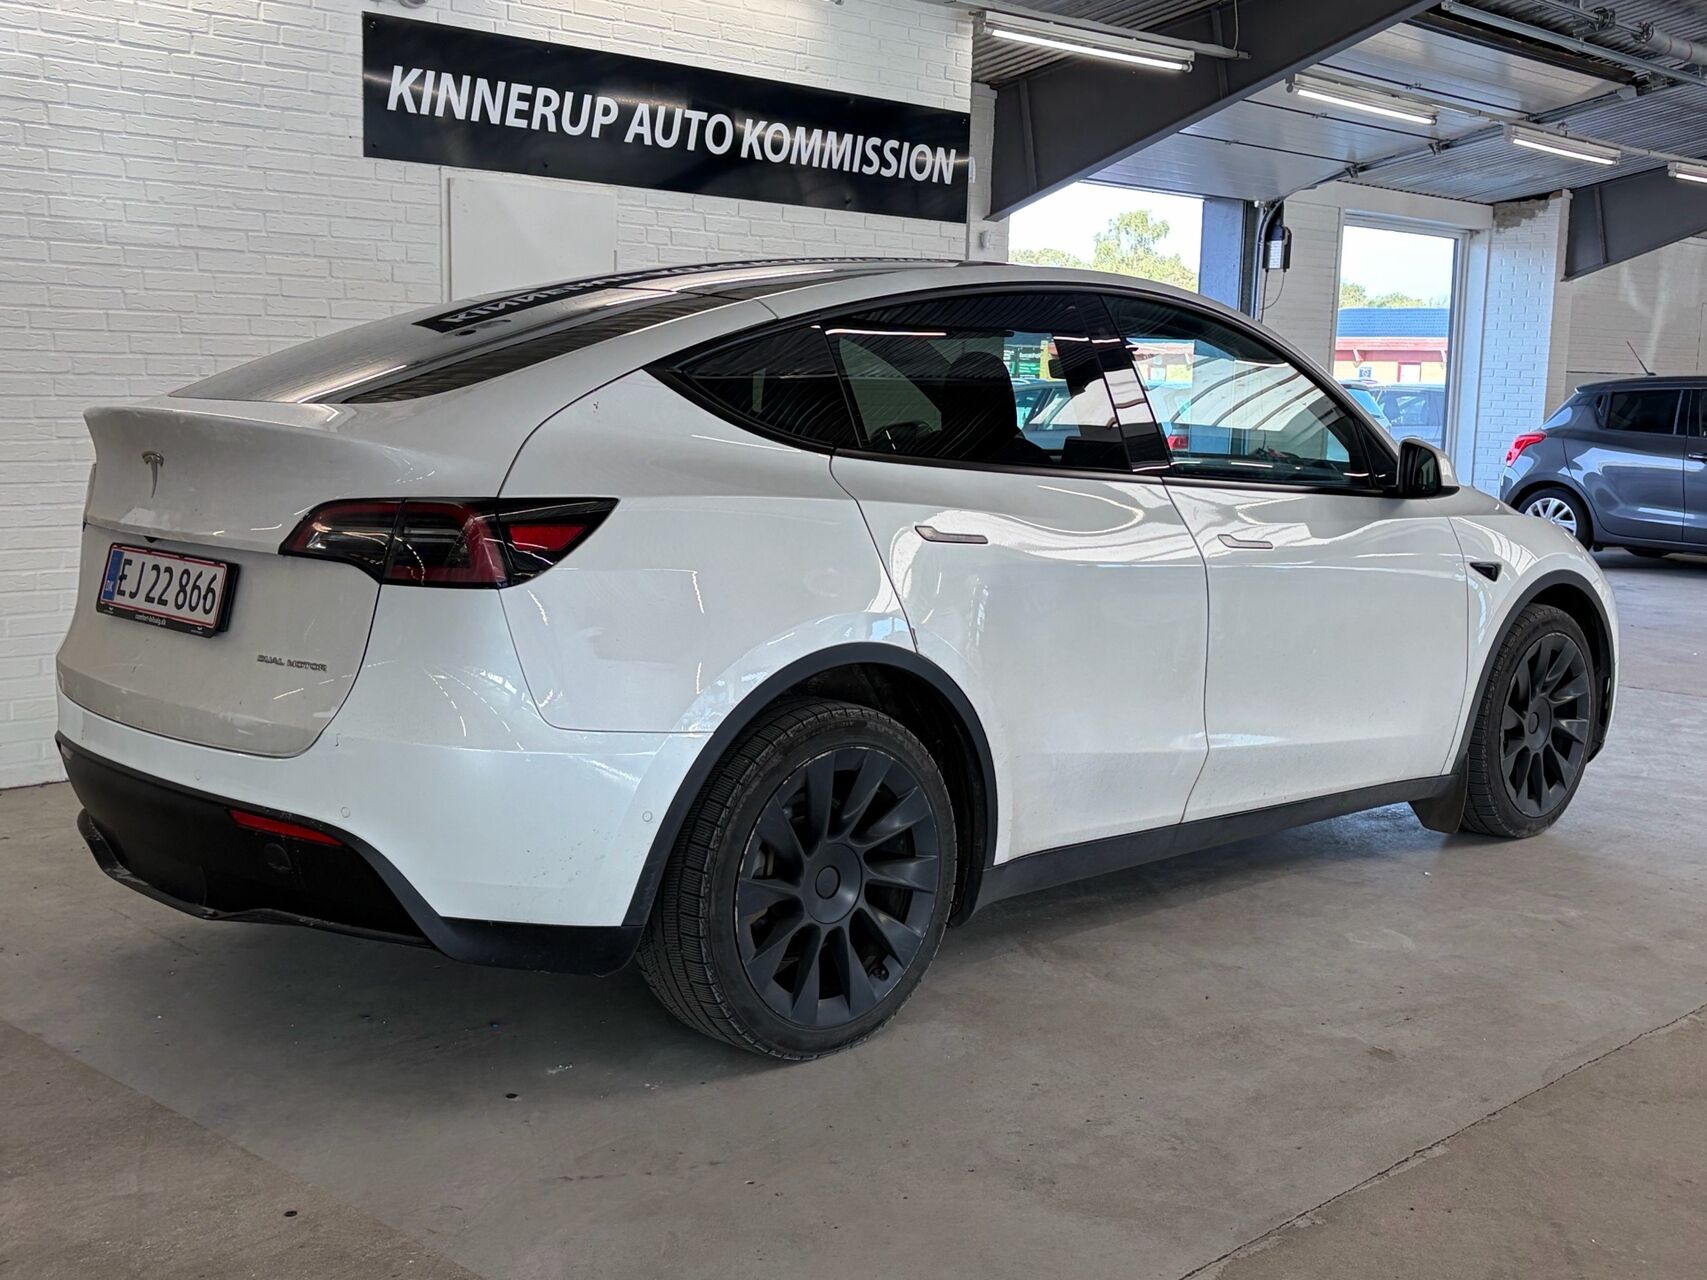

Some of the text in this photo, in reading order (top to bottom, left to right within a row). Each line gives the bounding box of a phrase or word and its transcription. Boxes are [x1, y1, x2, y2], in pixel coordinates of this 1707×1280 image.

[387, 65, 957, 185] KINNERUP AUTO KOMMISSION
[257, 654, 328, 672] DUAL MOTOR
